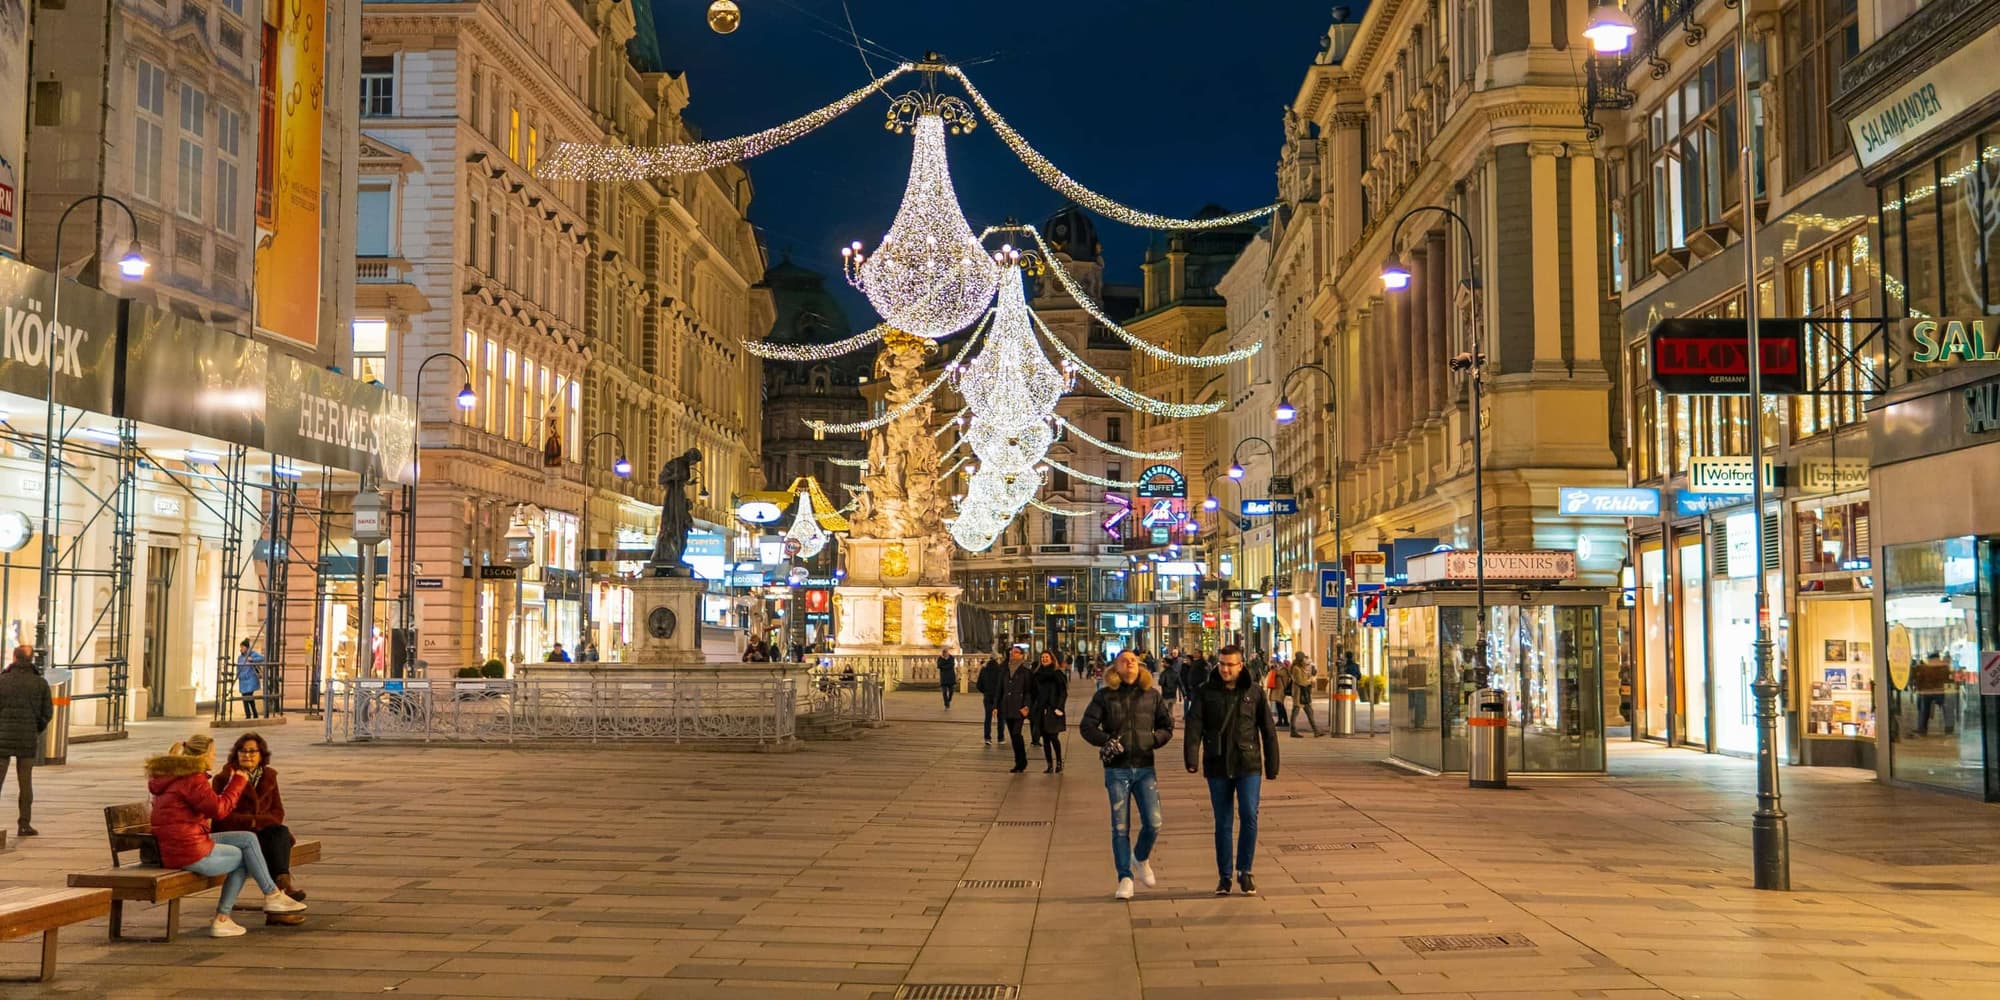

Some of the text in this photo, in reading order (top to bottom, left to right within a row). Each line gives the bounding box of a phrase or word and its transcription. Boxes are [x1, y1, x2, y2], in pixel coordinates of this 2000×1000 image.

[1860, 82, 1942, 153] SALAMANDER
[4, 298, 84, 378] KÖCK
[1913, 320, 2000, 362] SAL
[1709, 375, 1746, 383] GERMANY
[298, 391, 379, 455] HERMÈS
[1964, 383, 2000, 433] SAL
[1247, 501, 1290, 513] Berlitz
[1591, 495, 1655, 511] Tchibo
[484, 568, 517, 576] ESCADA
